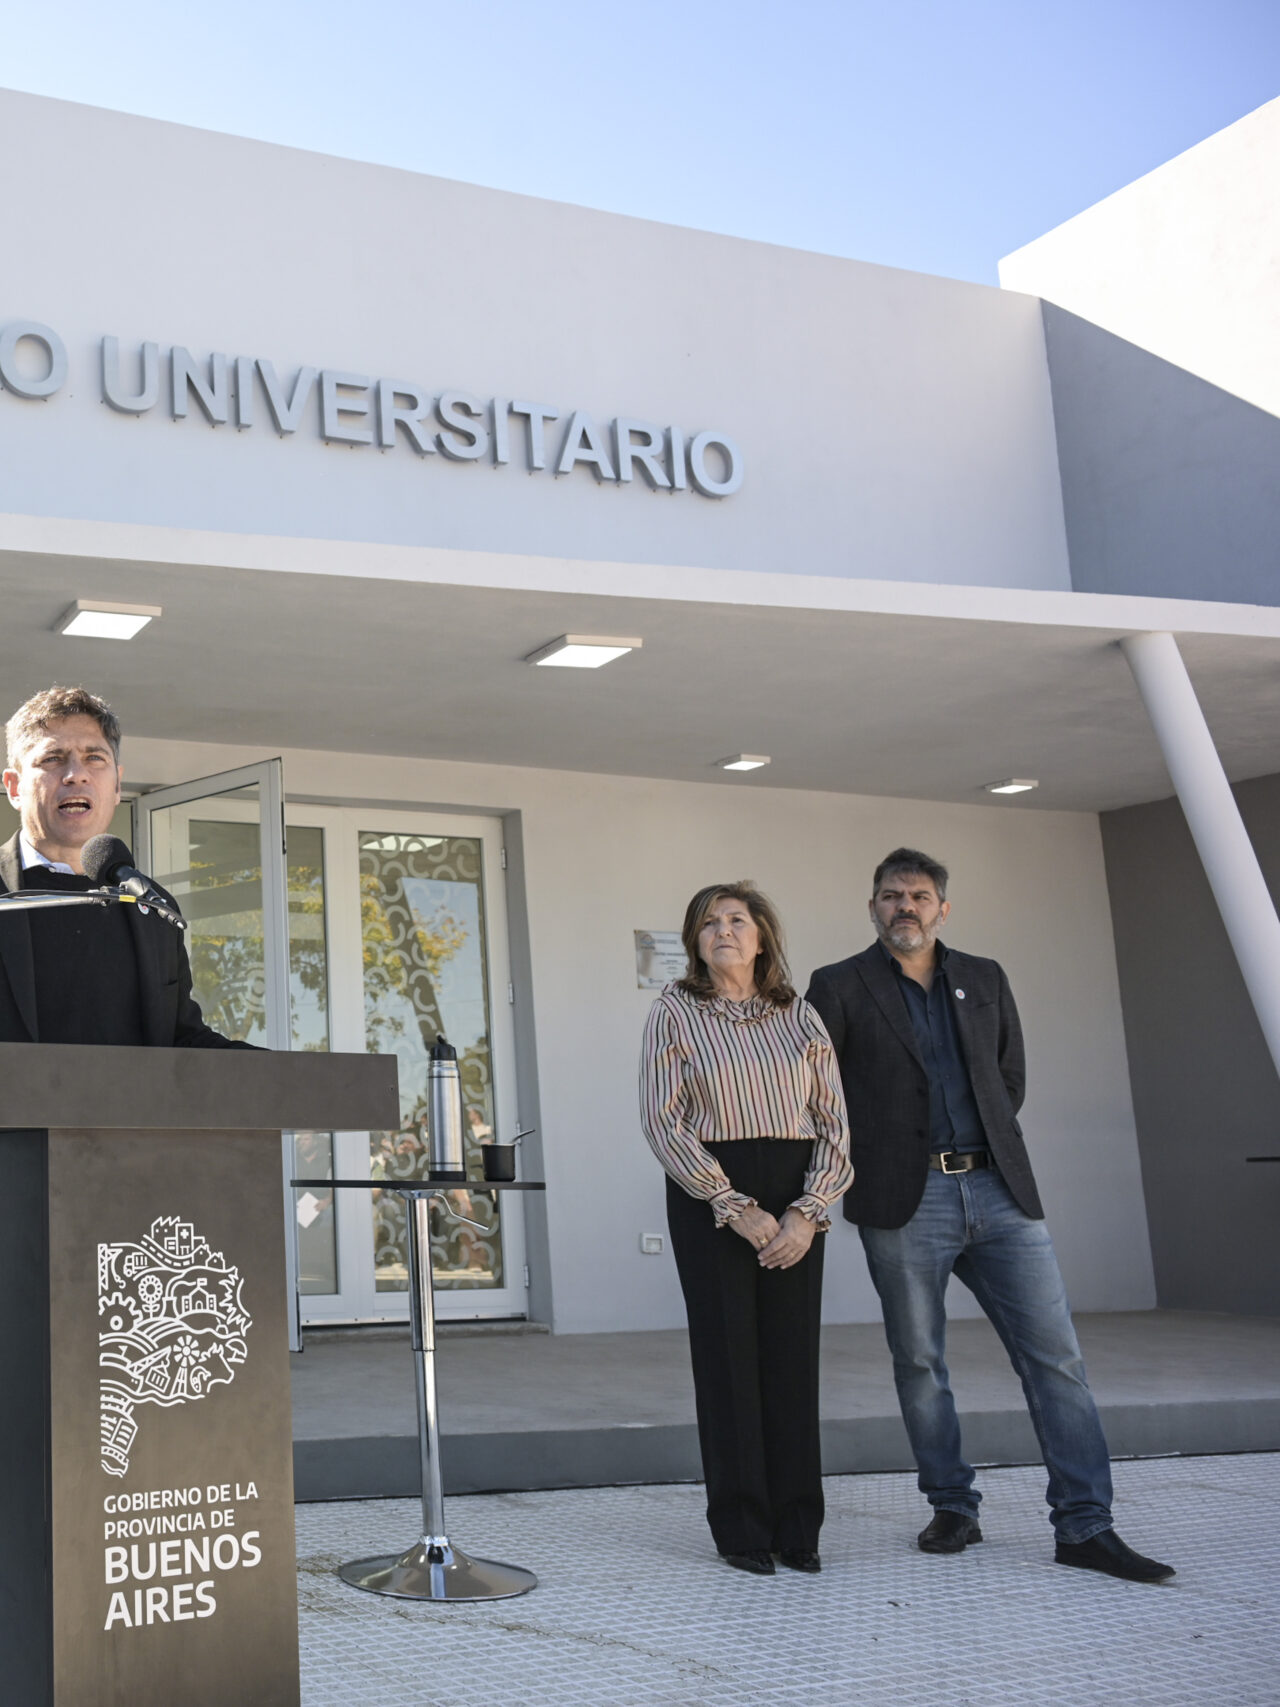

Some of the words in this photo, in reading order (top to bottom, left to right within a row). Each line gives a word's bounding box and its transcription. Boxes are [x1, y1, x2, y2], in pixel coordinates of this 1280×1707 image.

[100, 335, 744, 497] UNIVERSITARIO
[104, 1487, 202, 1514] GOBIERNO
[206, 1484, 231, 1504] DE
[235, 1482, 259, 1500] LA
[104, 1512, 206, 1540] PROVINCIA
[210, 1509, 235, 1529] DE
[105, 1531, 262, 1585] BUENOS
[104, 1580, 217, 1631] AIRES
